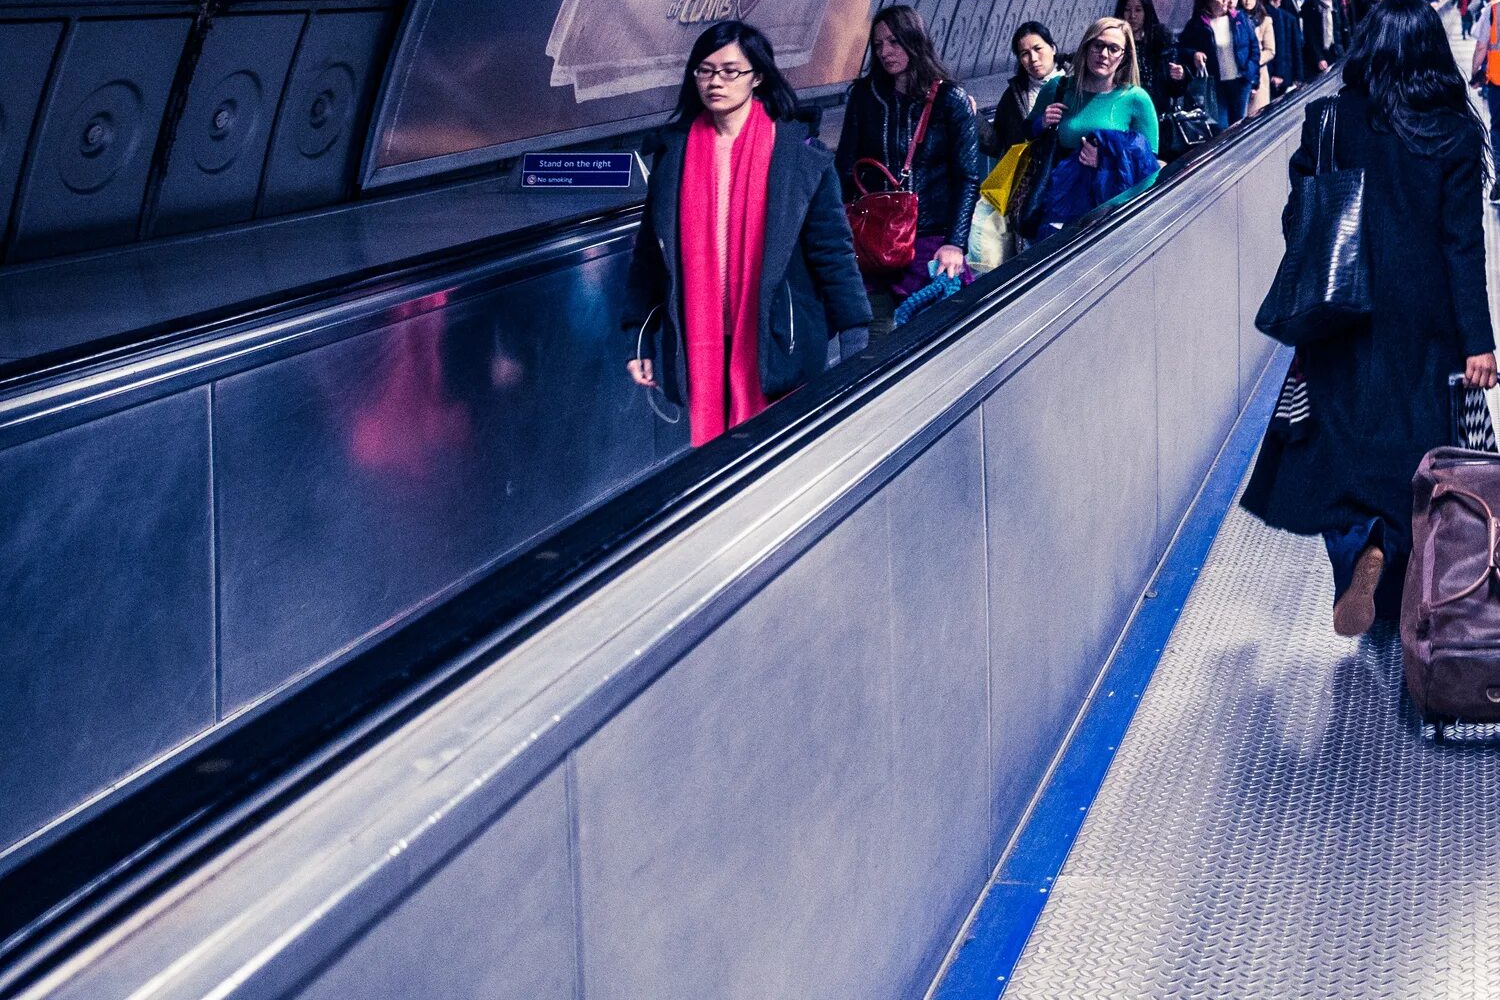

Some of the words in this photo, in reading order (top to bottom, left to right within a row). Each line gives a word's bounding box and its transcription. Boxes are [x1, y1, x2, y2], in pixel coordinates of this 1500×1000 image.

[539, 160, 562, 168] Stand
[576, 160, 591, 168] the
[592, 160, 612, 169] right
